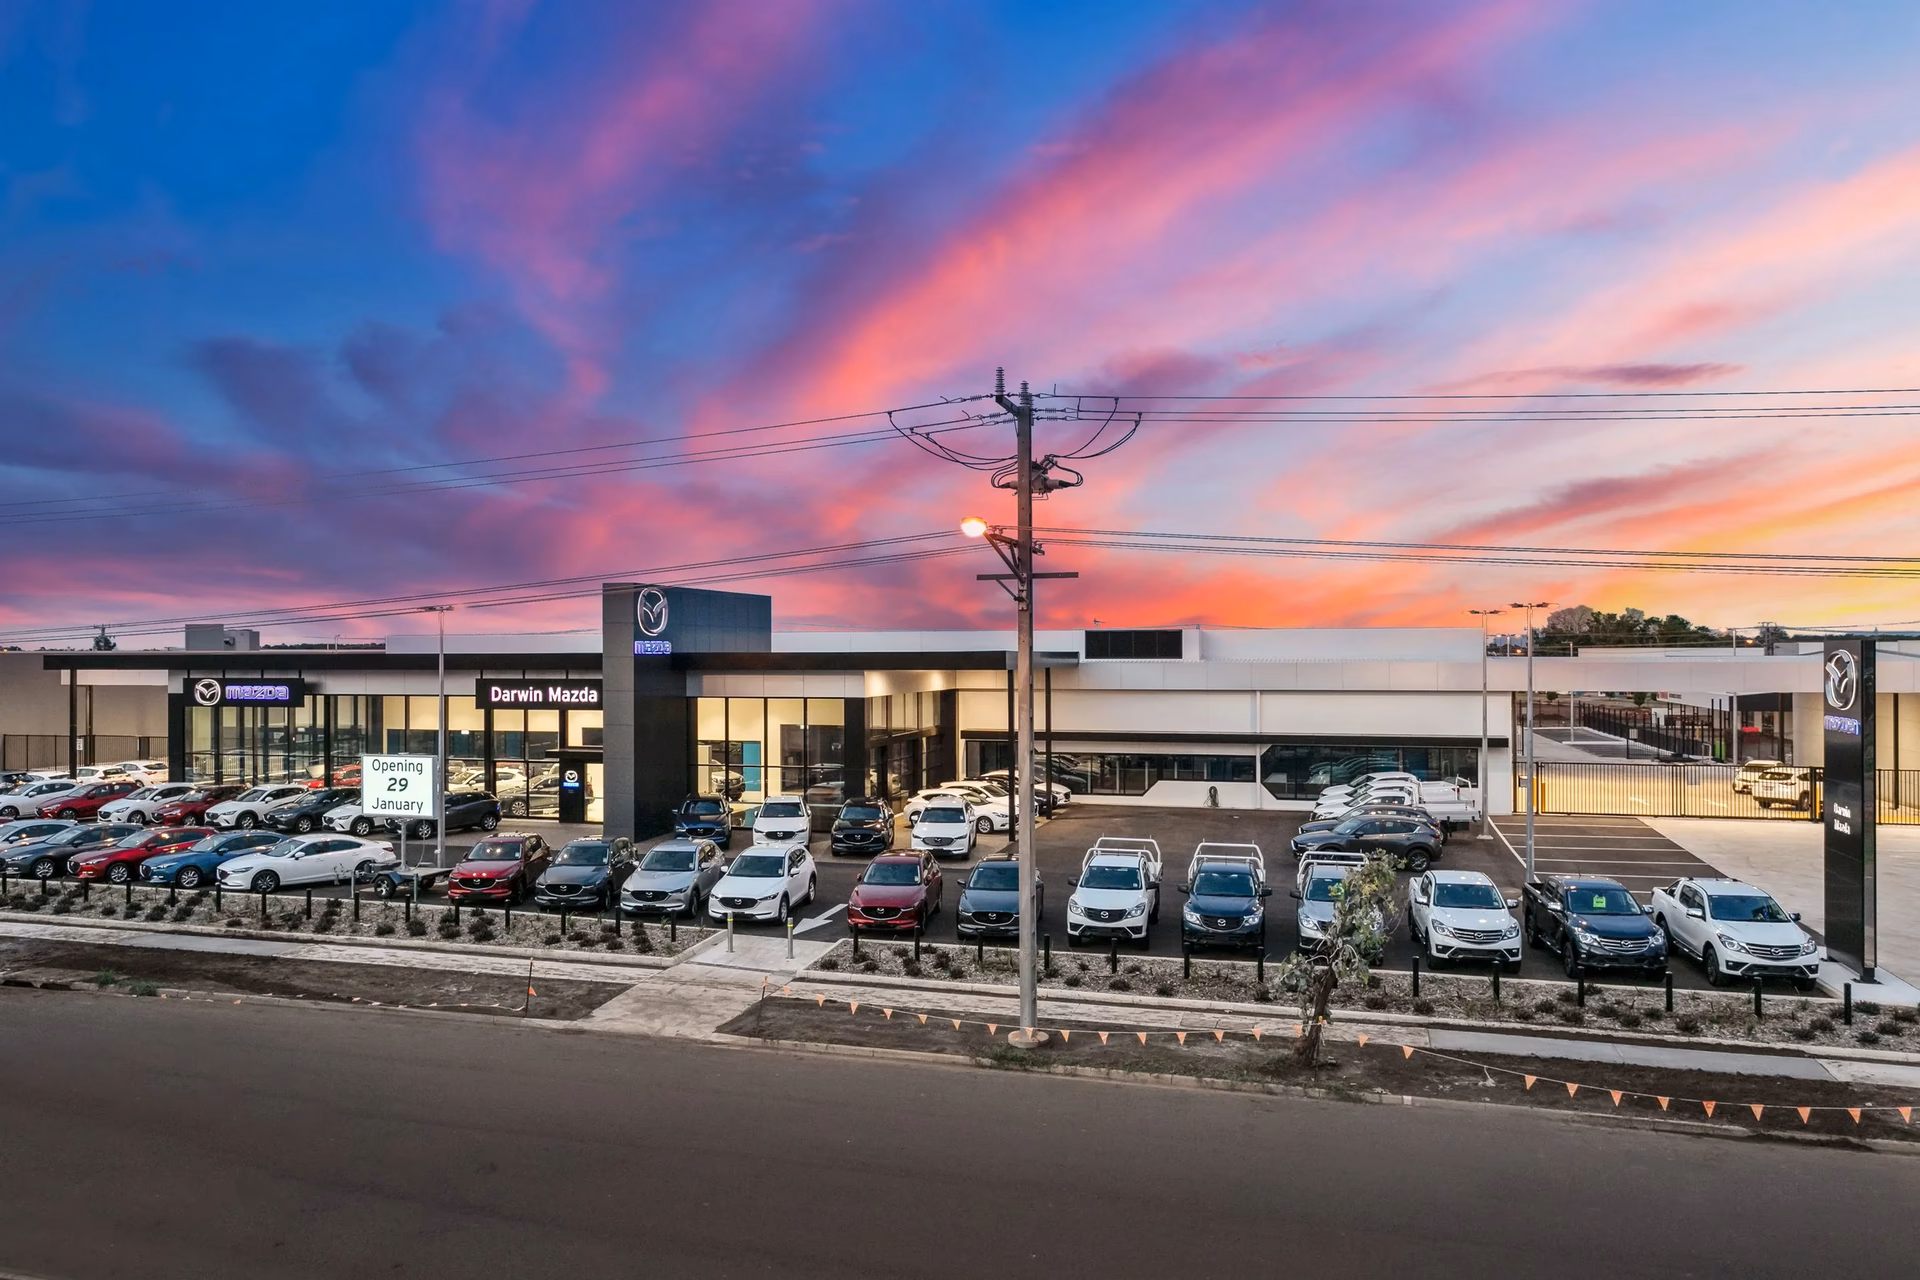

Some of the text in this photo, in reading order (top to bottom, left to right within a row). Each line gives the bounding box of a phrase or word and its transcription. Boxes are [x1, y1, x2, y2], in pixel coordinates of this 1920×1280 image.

[225, 685, 290, 700] mazda
[490, 686, 598, 702] Darwin Mazda
[372, 758, 423, 775] Opening
[387, 777, 409, 792] 29
[371, 797, 424, 814] January
